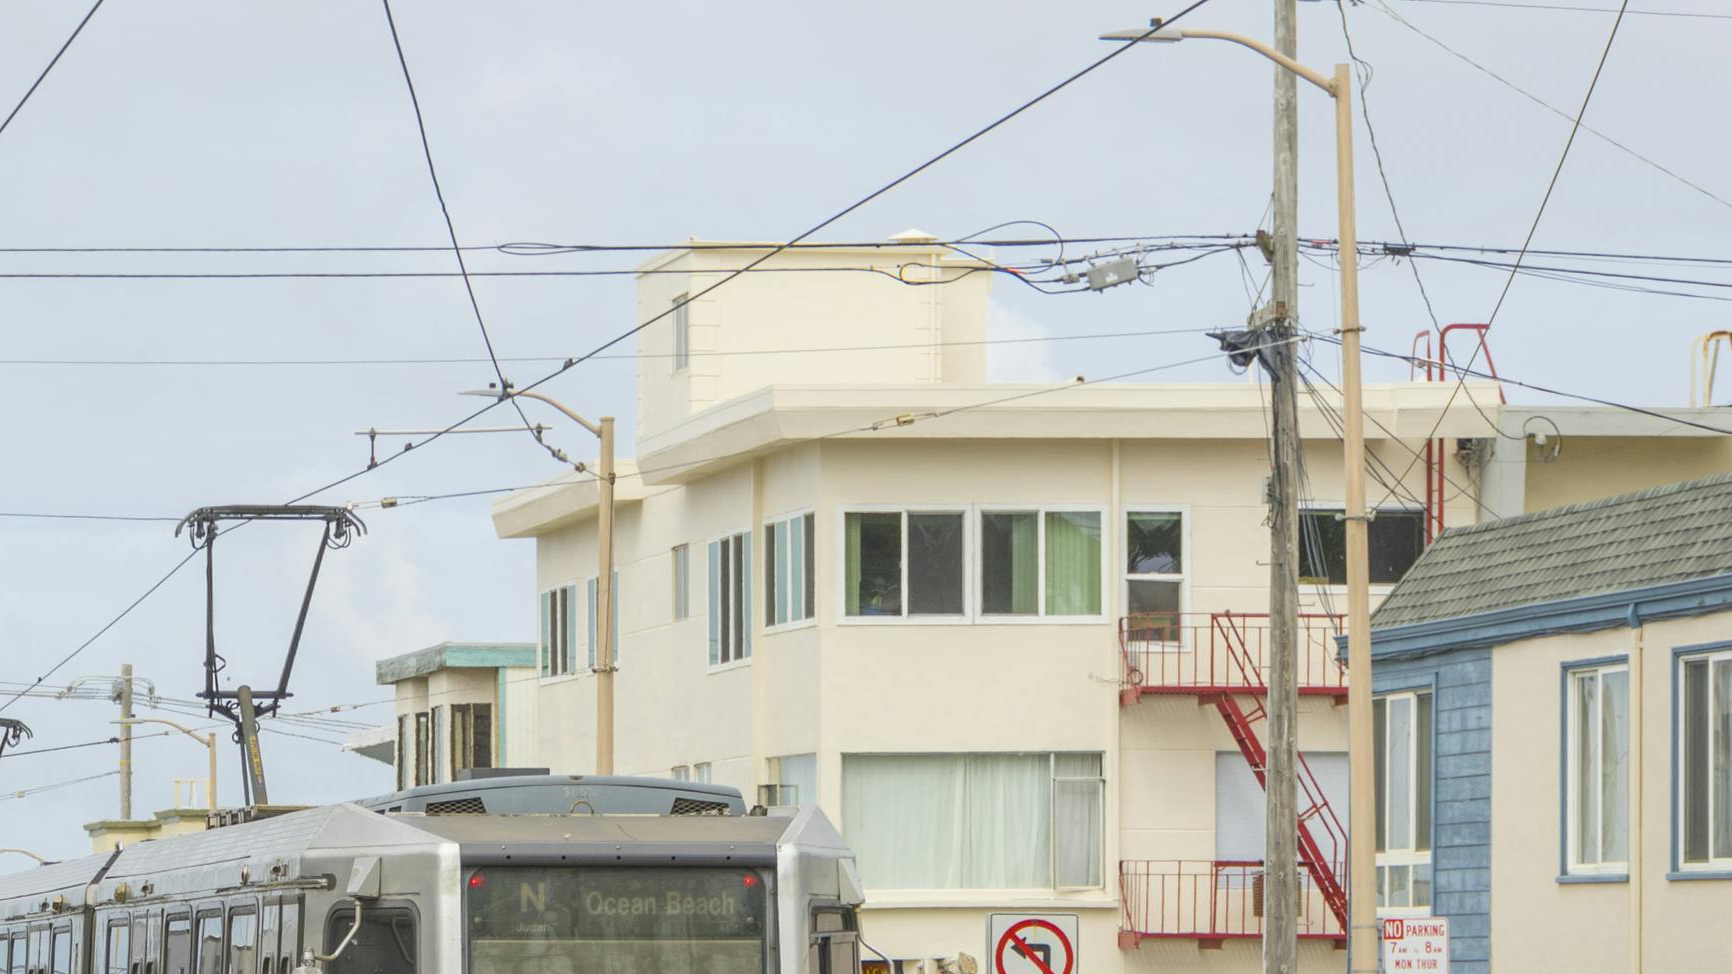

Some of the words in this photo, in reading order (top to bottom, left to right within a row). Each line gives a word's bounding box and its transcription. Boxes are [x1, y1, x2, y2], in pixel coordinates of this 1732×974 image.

[520, 882, 546, 912] N
[586, 890, 657, 916] Ocean
[666, 890, 735, 916] Beach
[1385, 921, 1402, 937] NO
[1406, 925, 1444, 937] PARKING
[1395, 960, 1412, 969] MON
[1417, 960, 1437, 969] THUR
